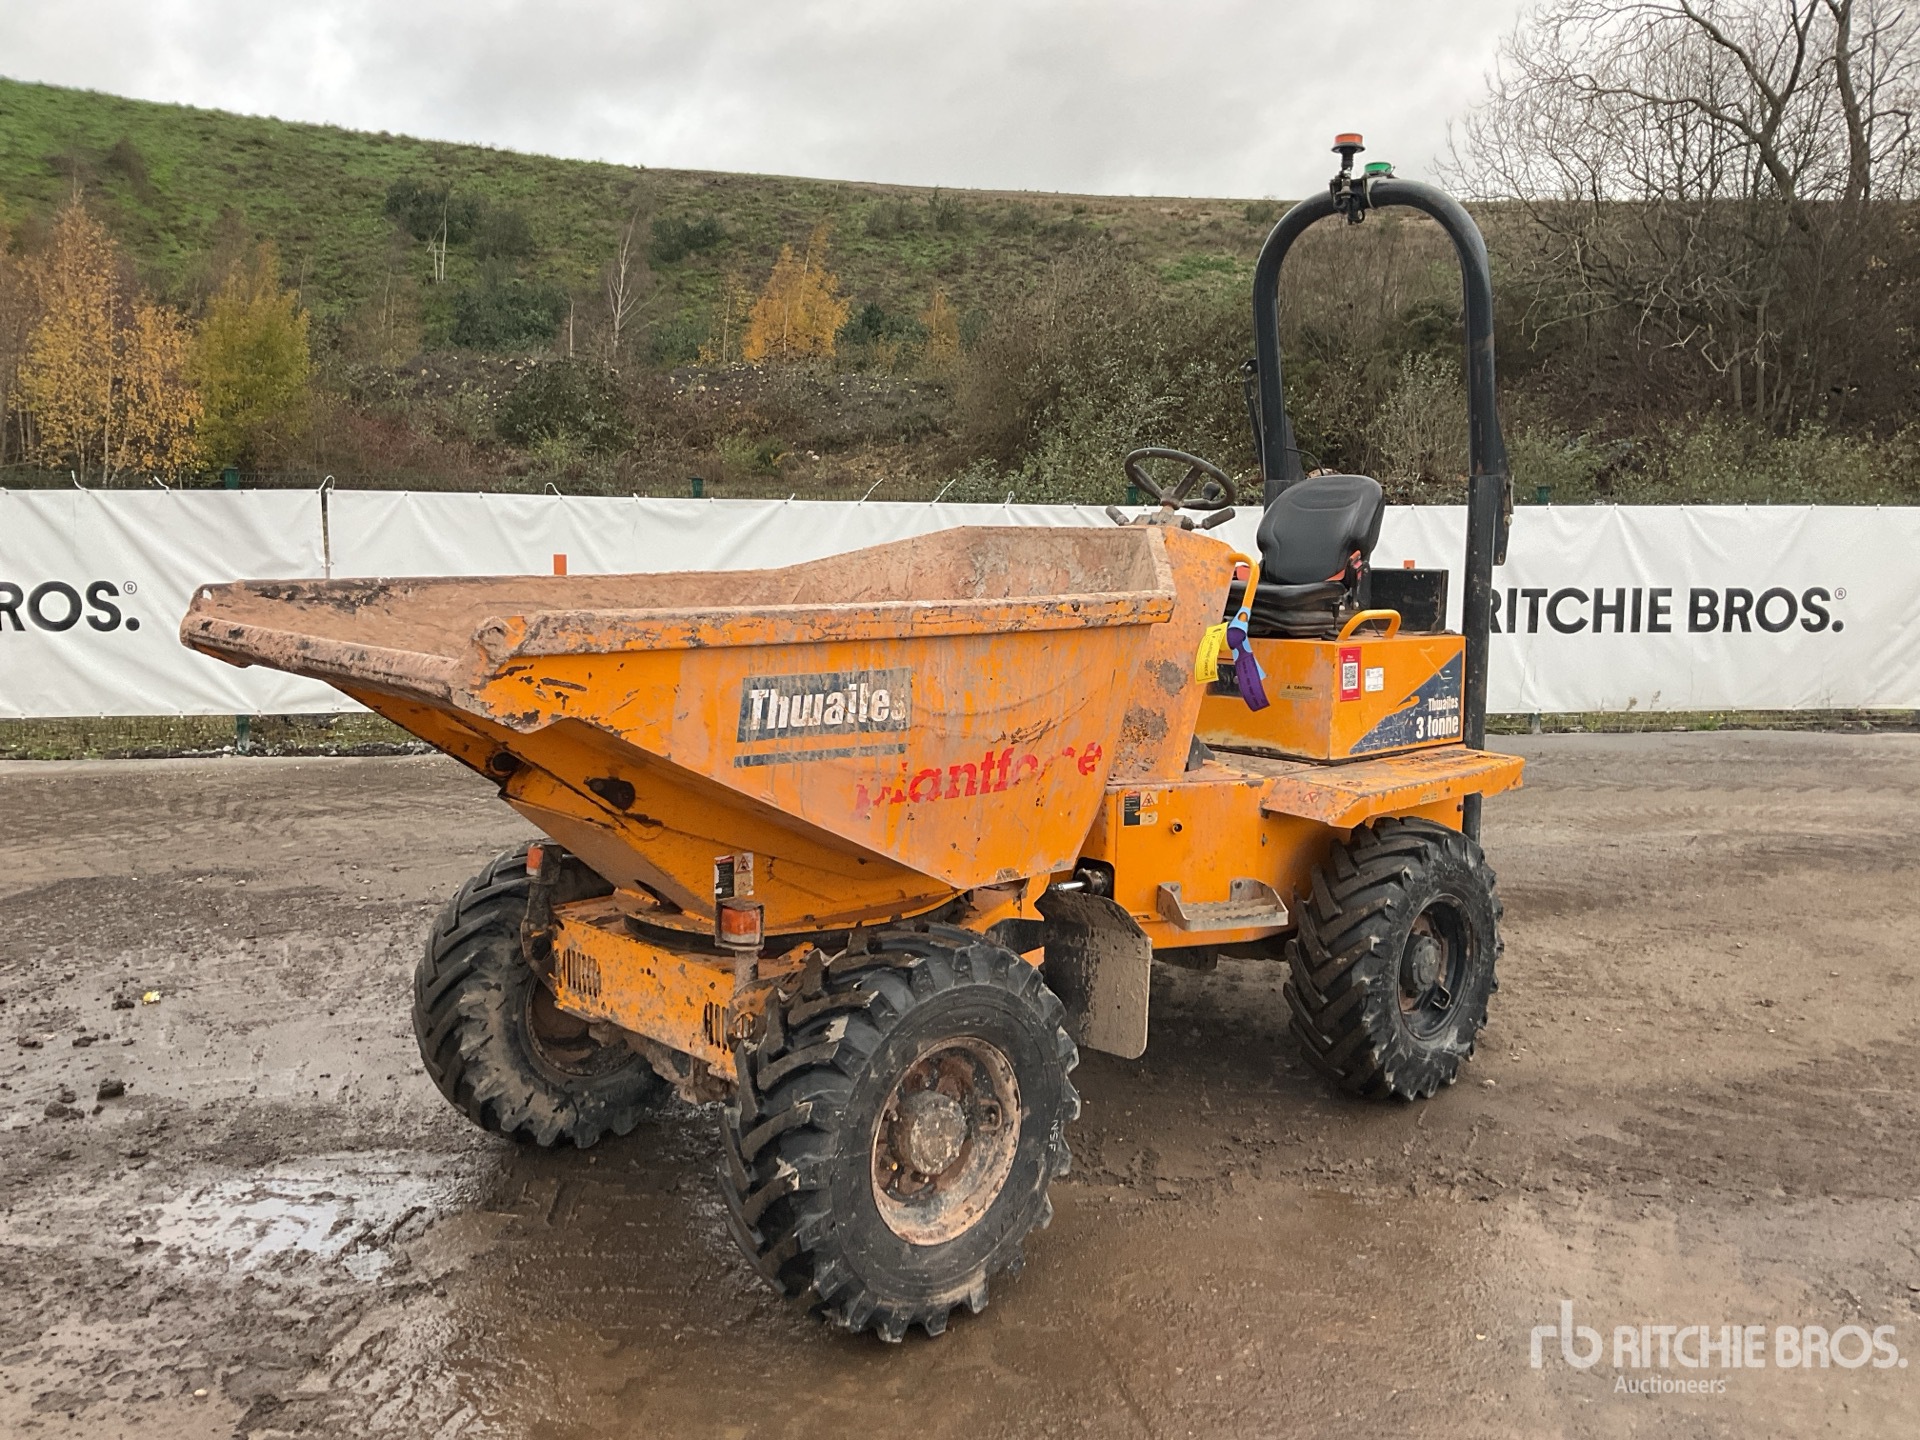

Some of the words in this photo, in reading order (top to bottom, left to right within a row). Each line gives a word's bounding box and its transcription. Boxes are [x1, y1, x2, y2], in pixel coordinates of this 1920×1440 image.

[1428, 695, 1459, 711] Thwaites
[1415, 716, 1425, 739] 3
[1427, 715, 1459, 737] tonne
